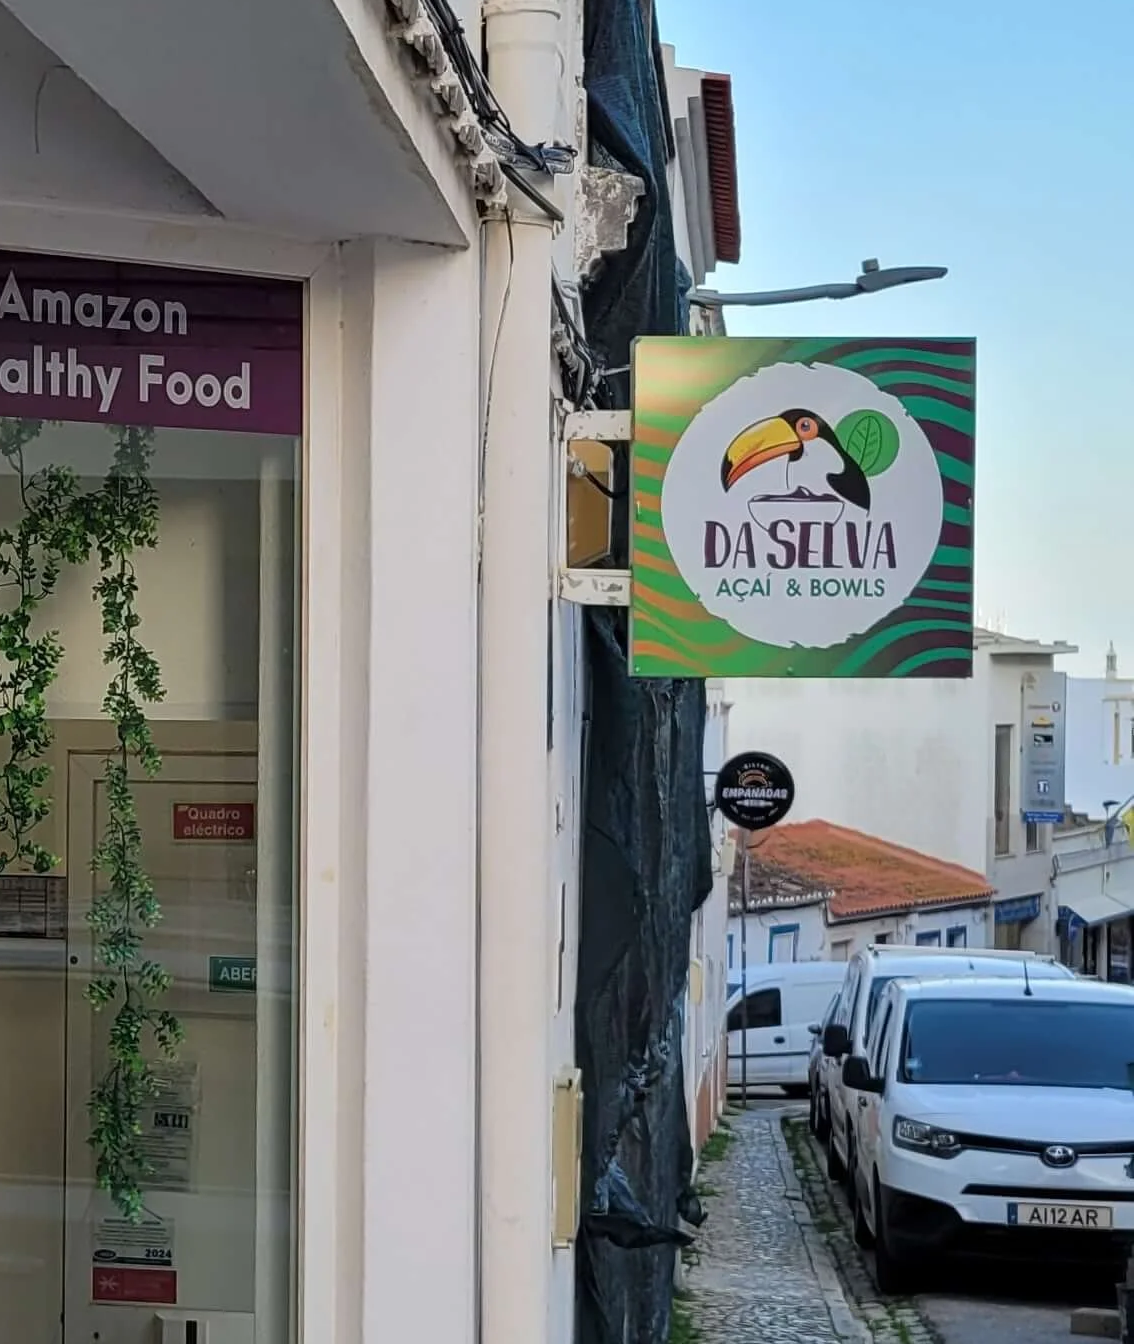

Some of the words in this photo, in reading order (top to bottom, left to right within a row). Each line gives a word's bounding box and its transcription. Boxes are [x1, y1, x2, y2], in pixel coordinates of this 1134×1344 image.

[139, 354, 252, 410] Food
[703, 520, 757, 569] DA
[766, 519, 897, 570] SELVA
[716, 572, 771, 602] AÇAÍ
[786, 578, 802, 597] &
[810, 578, 885, 598] BOWLS
[722, 786, 787, 799] EMPANADAS
[188, 807, 241, 820] Quadro
[183, 822, 245, 836] eléctrico
